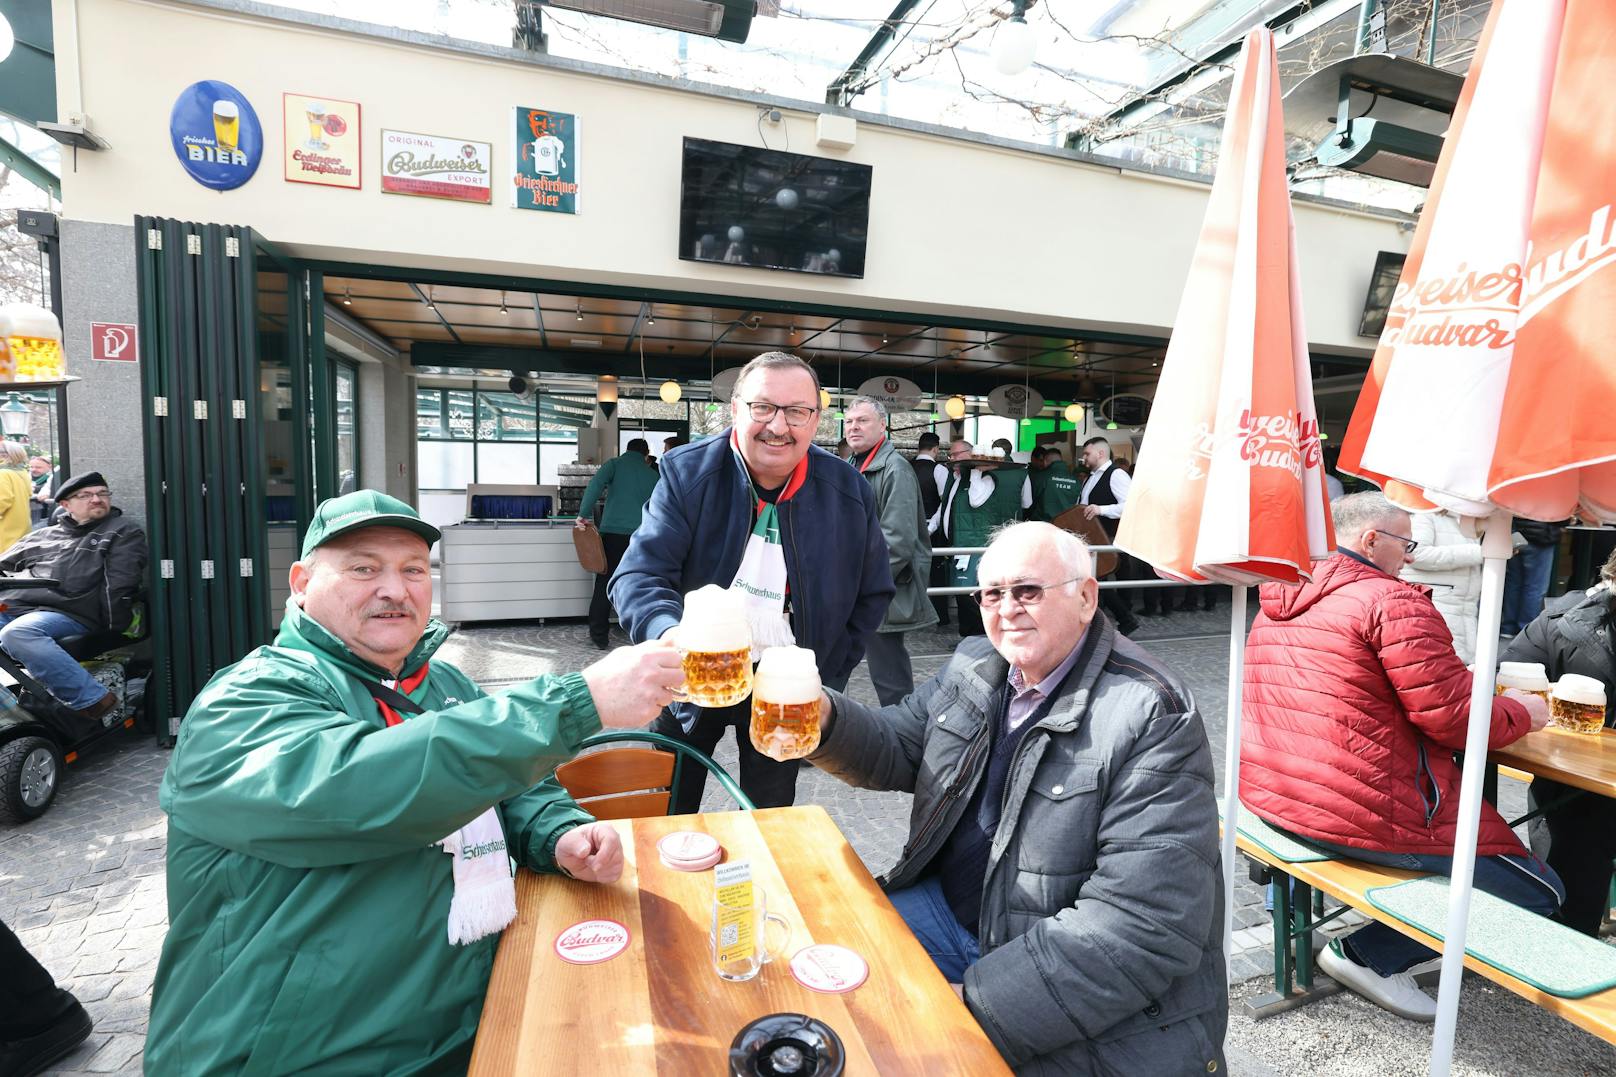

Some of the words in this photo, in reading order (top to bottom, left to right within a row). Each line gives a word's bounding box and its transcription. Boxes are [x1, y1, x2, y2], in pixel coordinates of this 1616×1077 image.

[388, 135, 435, 148] ORIGINAL
[186, 143, 248, 167] BIER
[387, 151, 488, 177] Budweiser
[447, 174, 484, 185] EXPORT
[532, 189, 559, 206] Bier
[559, 932, 625, 950] Budvar
